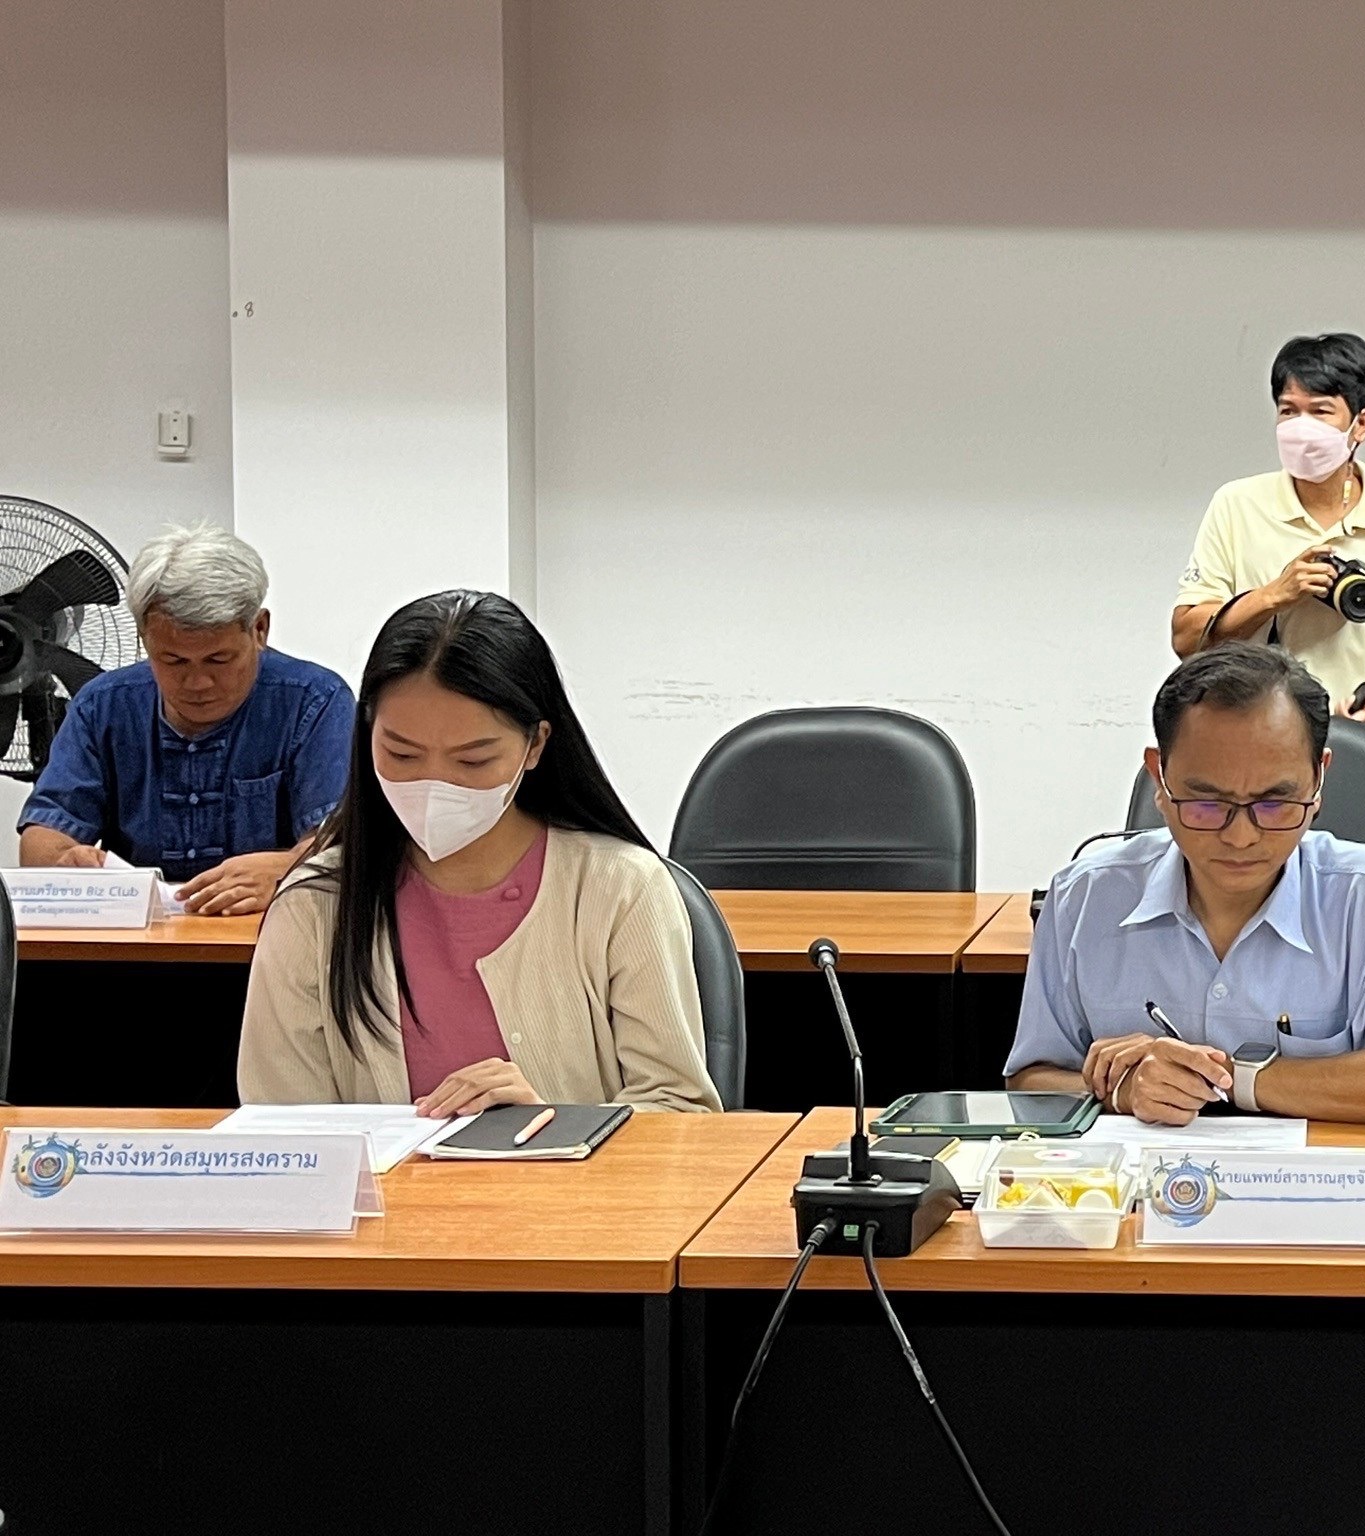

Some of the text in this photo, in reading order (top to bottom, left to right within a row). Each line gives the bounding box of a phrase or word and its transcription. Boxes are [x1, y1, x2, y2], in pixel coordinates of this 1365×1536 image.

[86, 885, 105, 897] Biz
[109, 885, 139, 897] Club
[77, 1142, 318, 1173] คลังจังหวัดสมุทรสงคราม
